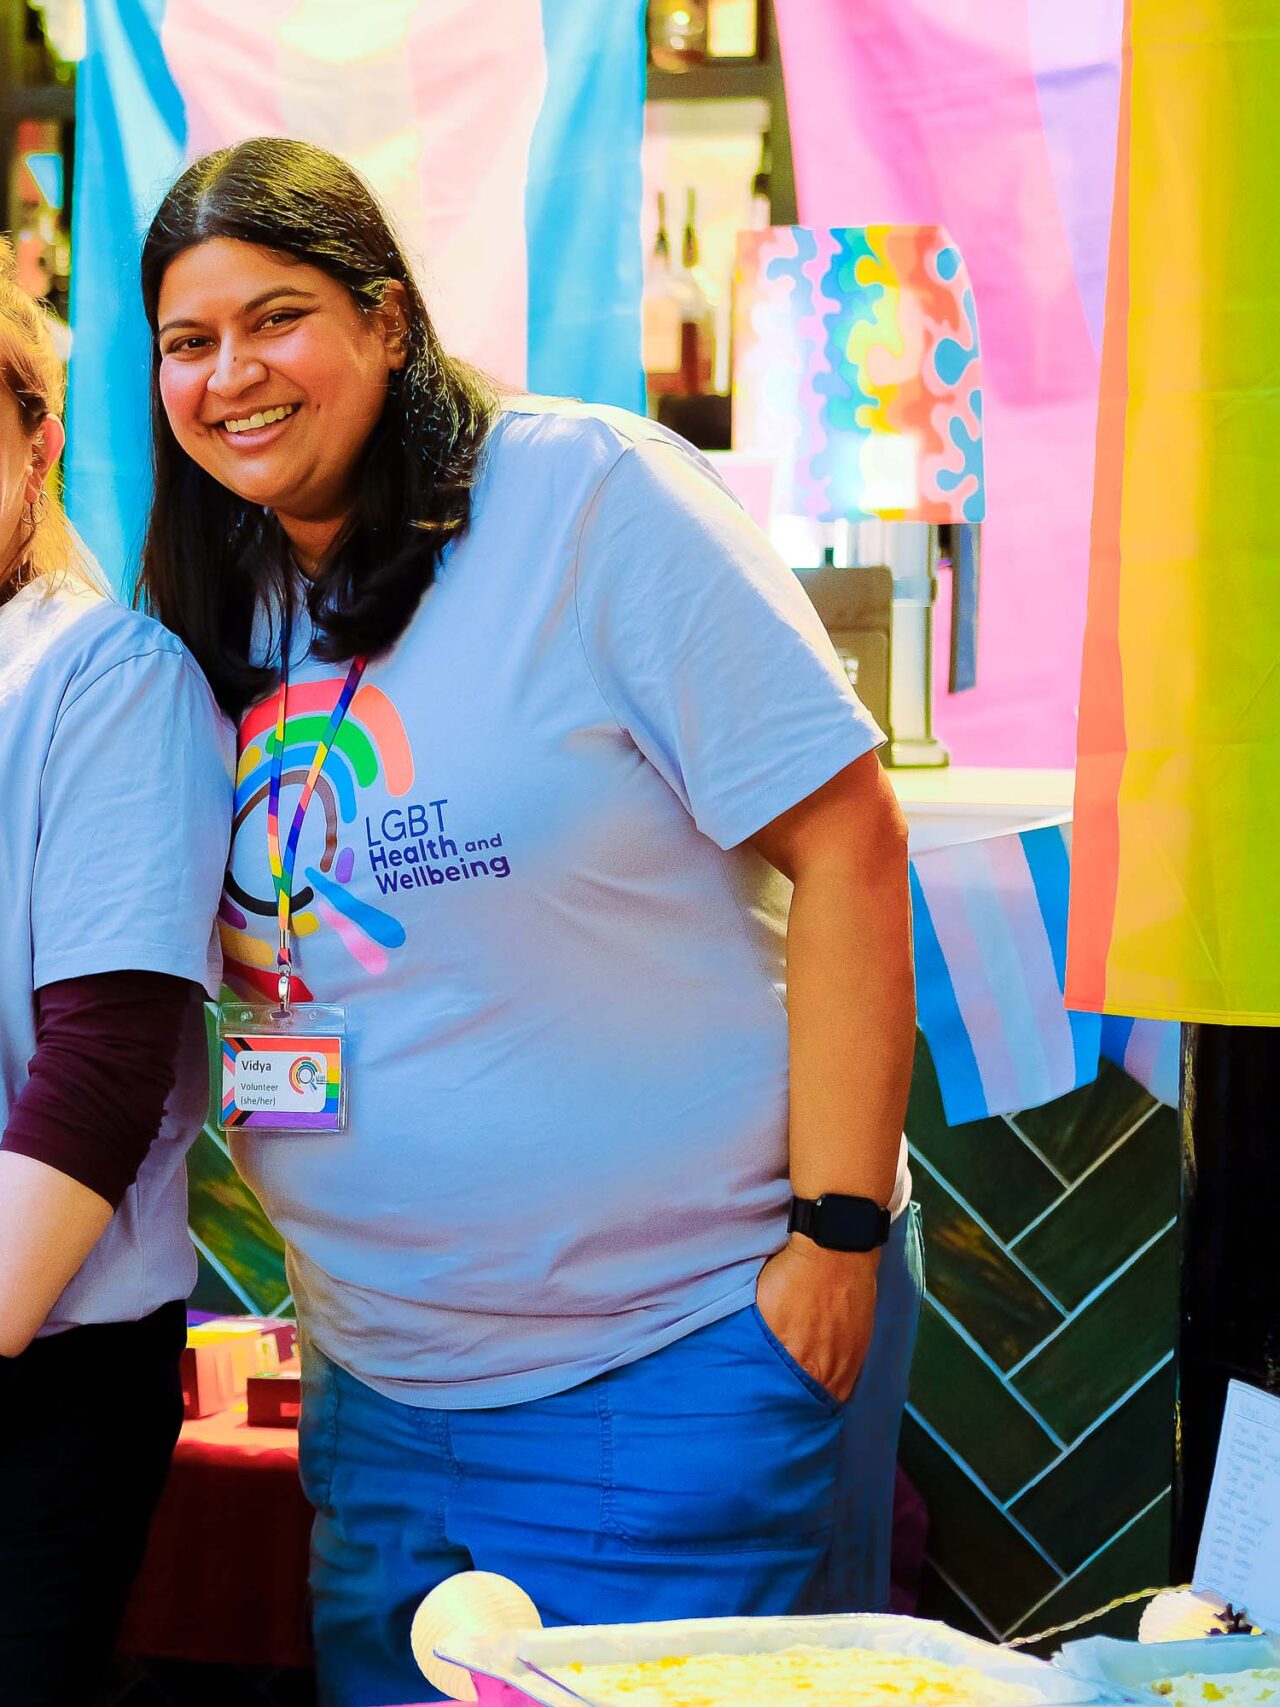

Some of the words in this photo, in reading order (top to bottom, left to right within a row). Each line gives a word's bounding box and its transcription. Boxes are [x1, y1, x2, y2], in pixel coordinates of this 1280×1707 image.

[366, 799, 448, 847] LGBT
[369, 834, 458, 872] Health
[464, 833, 503, 852] and
[375, 855, 511, 895] Wellbeing
[241, 1060, 272, 1073] Vidya
[240, 1082, 279, 1092] Volunteer
[240, 1096, 276, 1106] (she/her)
